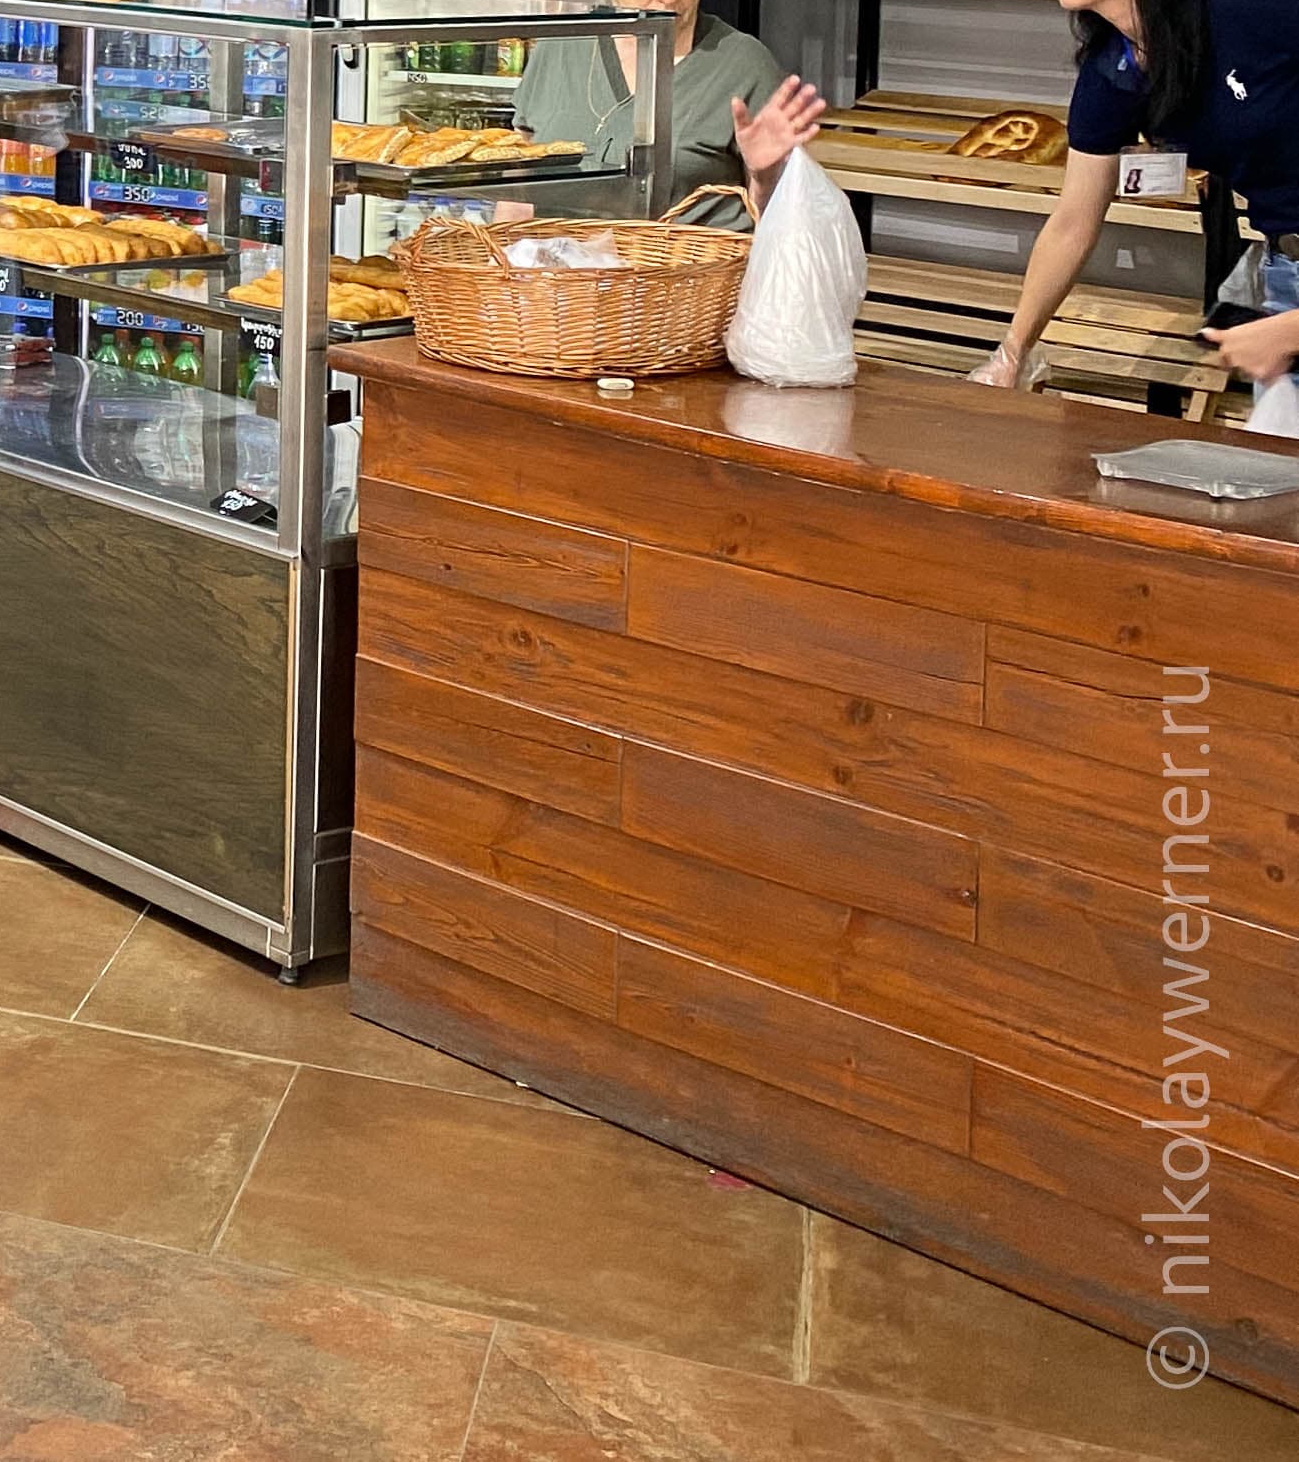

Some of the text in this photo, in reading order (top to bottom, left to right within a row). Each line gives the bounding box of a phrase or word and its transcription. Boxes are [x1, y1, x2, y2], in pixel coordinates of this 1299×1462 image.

[124, 156, 144, 169] 300
[124, 186, 150, 202] 350
[116, 310, 144, 326] 200
[254, 334, 274, 350] 150
